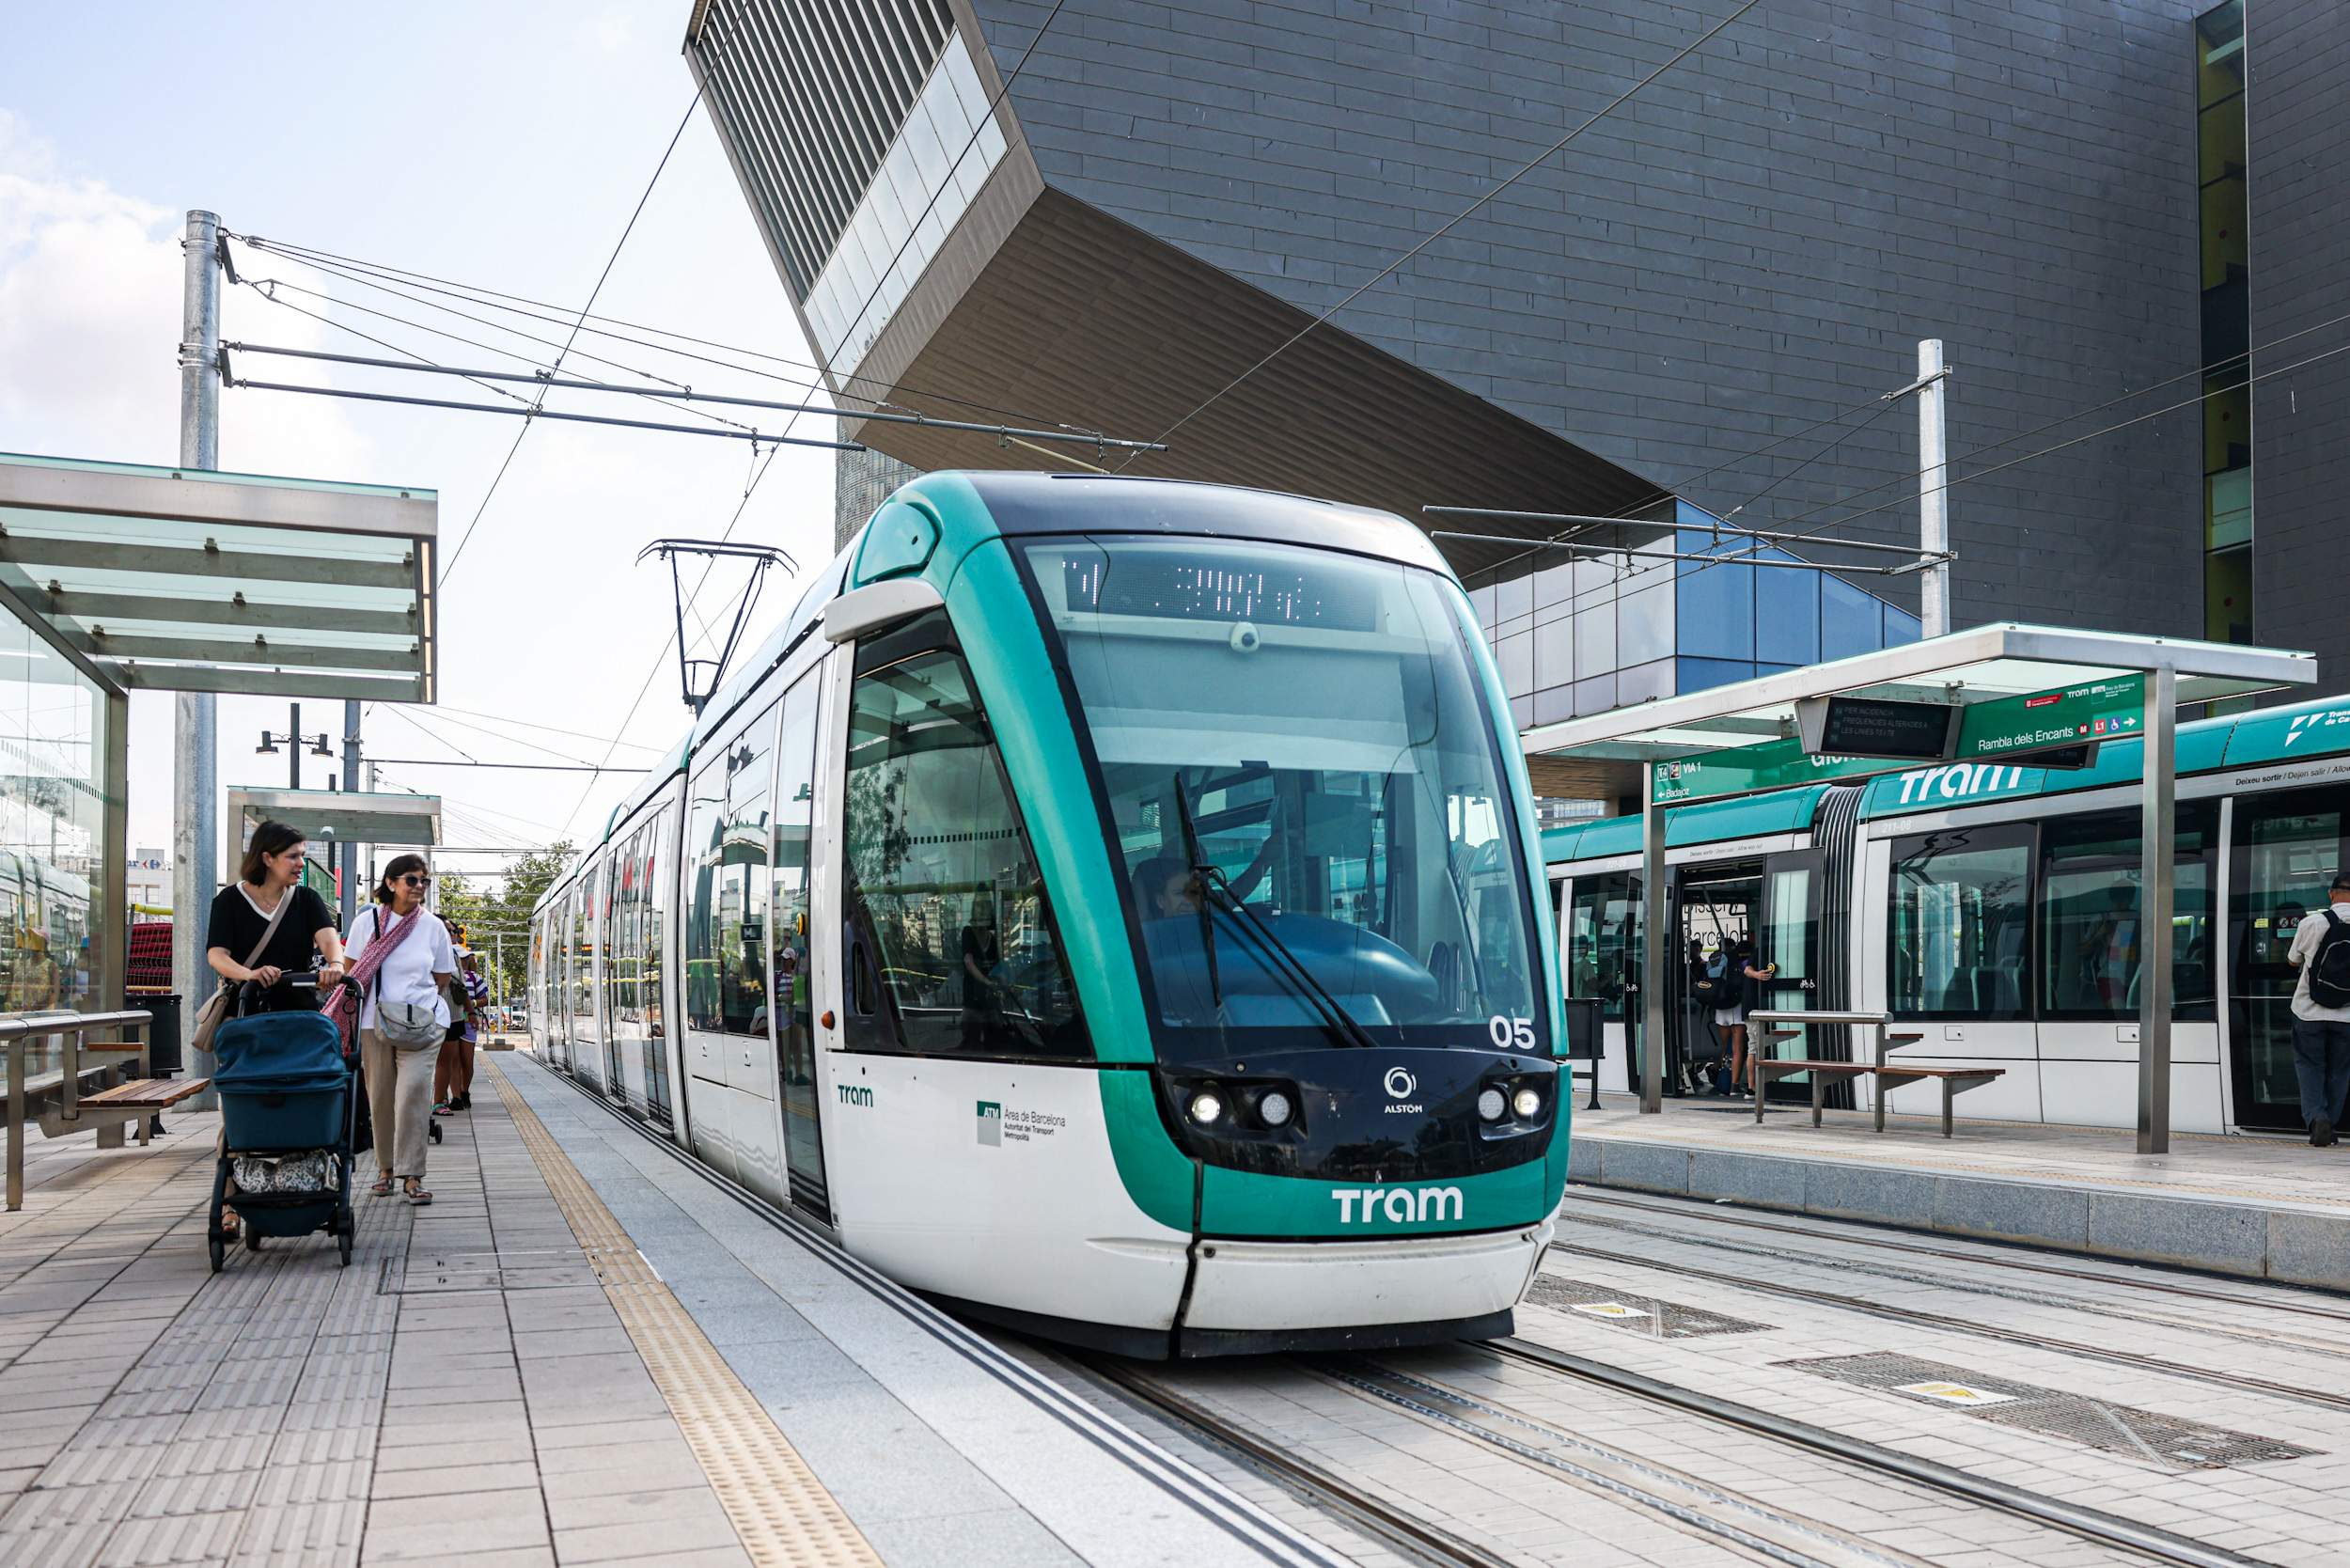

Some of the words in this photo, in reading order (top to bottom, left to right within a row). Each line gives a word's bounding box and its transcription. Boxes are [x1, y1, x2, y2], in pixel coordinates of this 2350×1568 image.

[2094, 721, 2105, 731] L1
[1978, 736, 2013, 751] Rambla
[2014, 732, 2034, 745] dels
[2035, 727, 2074, 743] Encants
[1684, 762, 1696, 774] VIA
[1697, 761, 1701, 772] 1
[2235, 776, 2260, 786] Deixeu
[2262, 773, 2281, 782] sortir
[2287, 770, 2309, 780] Dejen
[2311, 768, 2325, 776] salir
[1489, 1015, 1536, 1049] 05
[983, 1106, 999, 1120] ATM
[1384, 1104, 1422, 1114] ALSTOM
[1021, 1111, 1029, 1122] de
[1030, 1111, 1066, 1127] Barcelona
[1032, 1125, 1054, 1136] Transport
